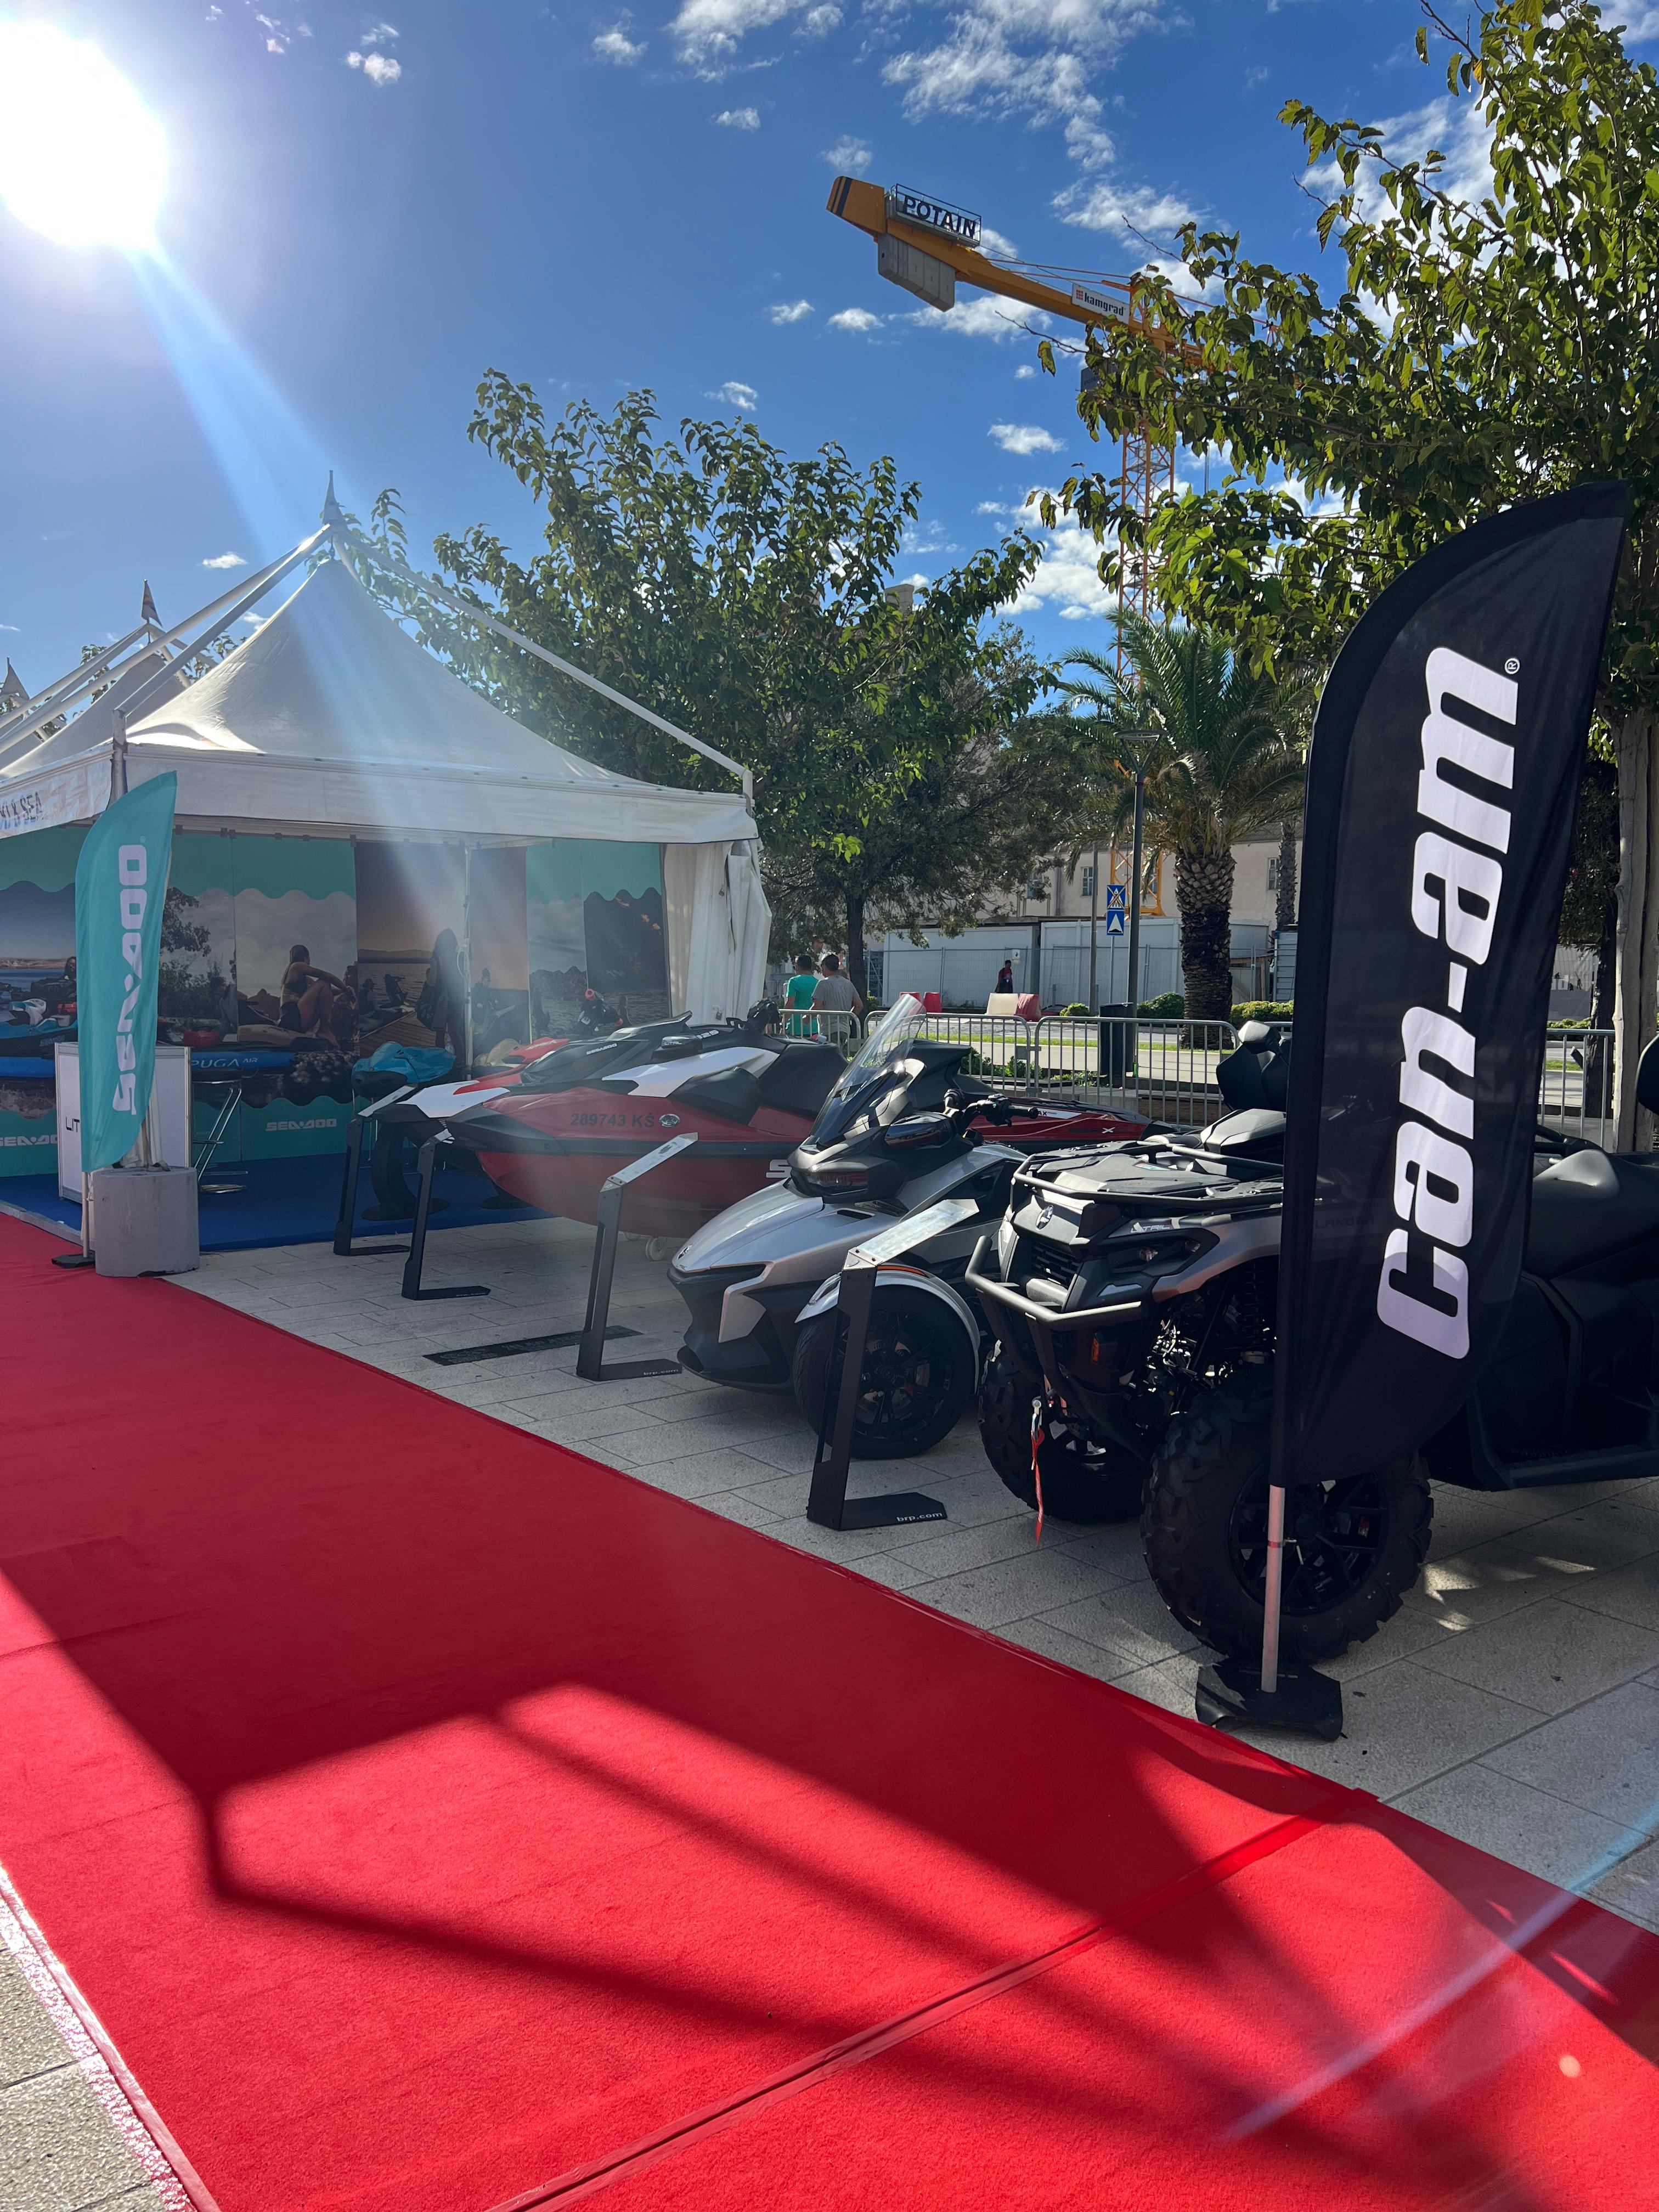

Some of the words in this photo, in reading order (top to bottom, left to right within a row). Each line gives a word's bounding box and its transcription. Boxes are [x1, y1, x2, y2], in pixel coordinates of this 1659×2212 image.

[904, 194, 975, 240] POTAIN
[1084, 292, 1124, 317] kamgrad
[571, 1114, 626, 1127] 289743
[632, 1112, 655, 1127] KŠ
[896, 1513, 943, 1521] brp.com
